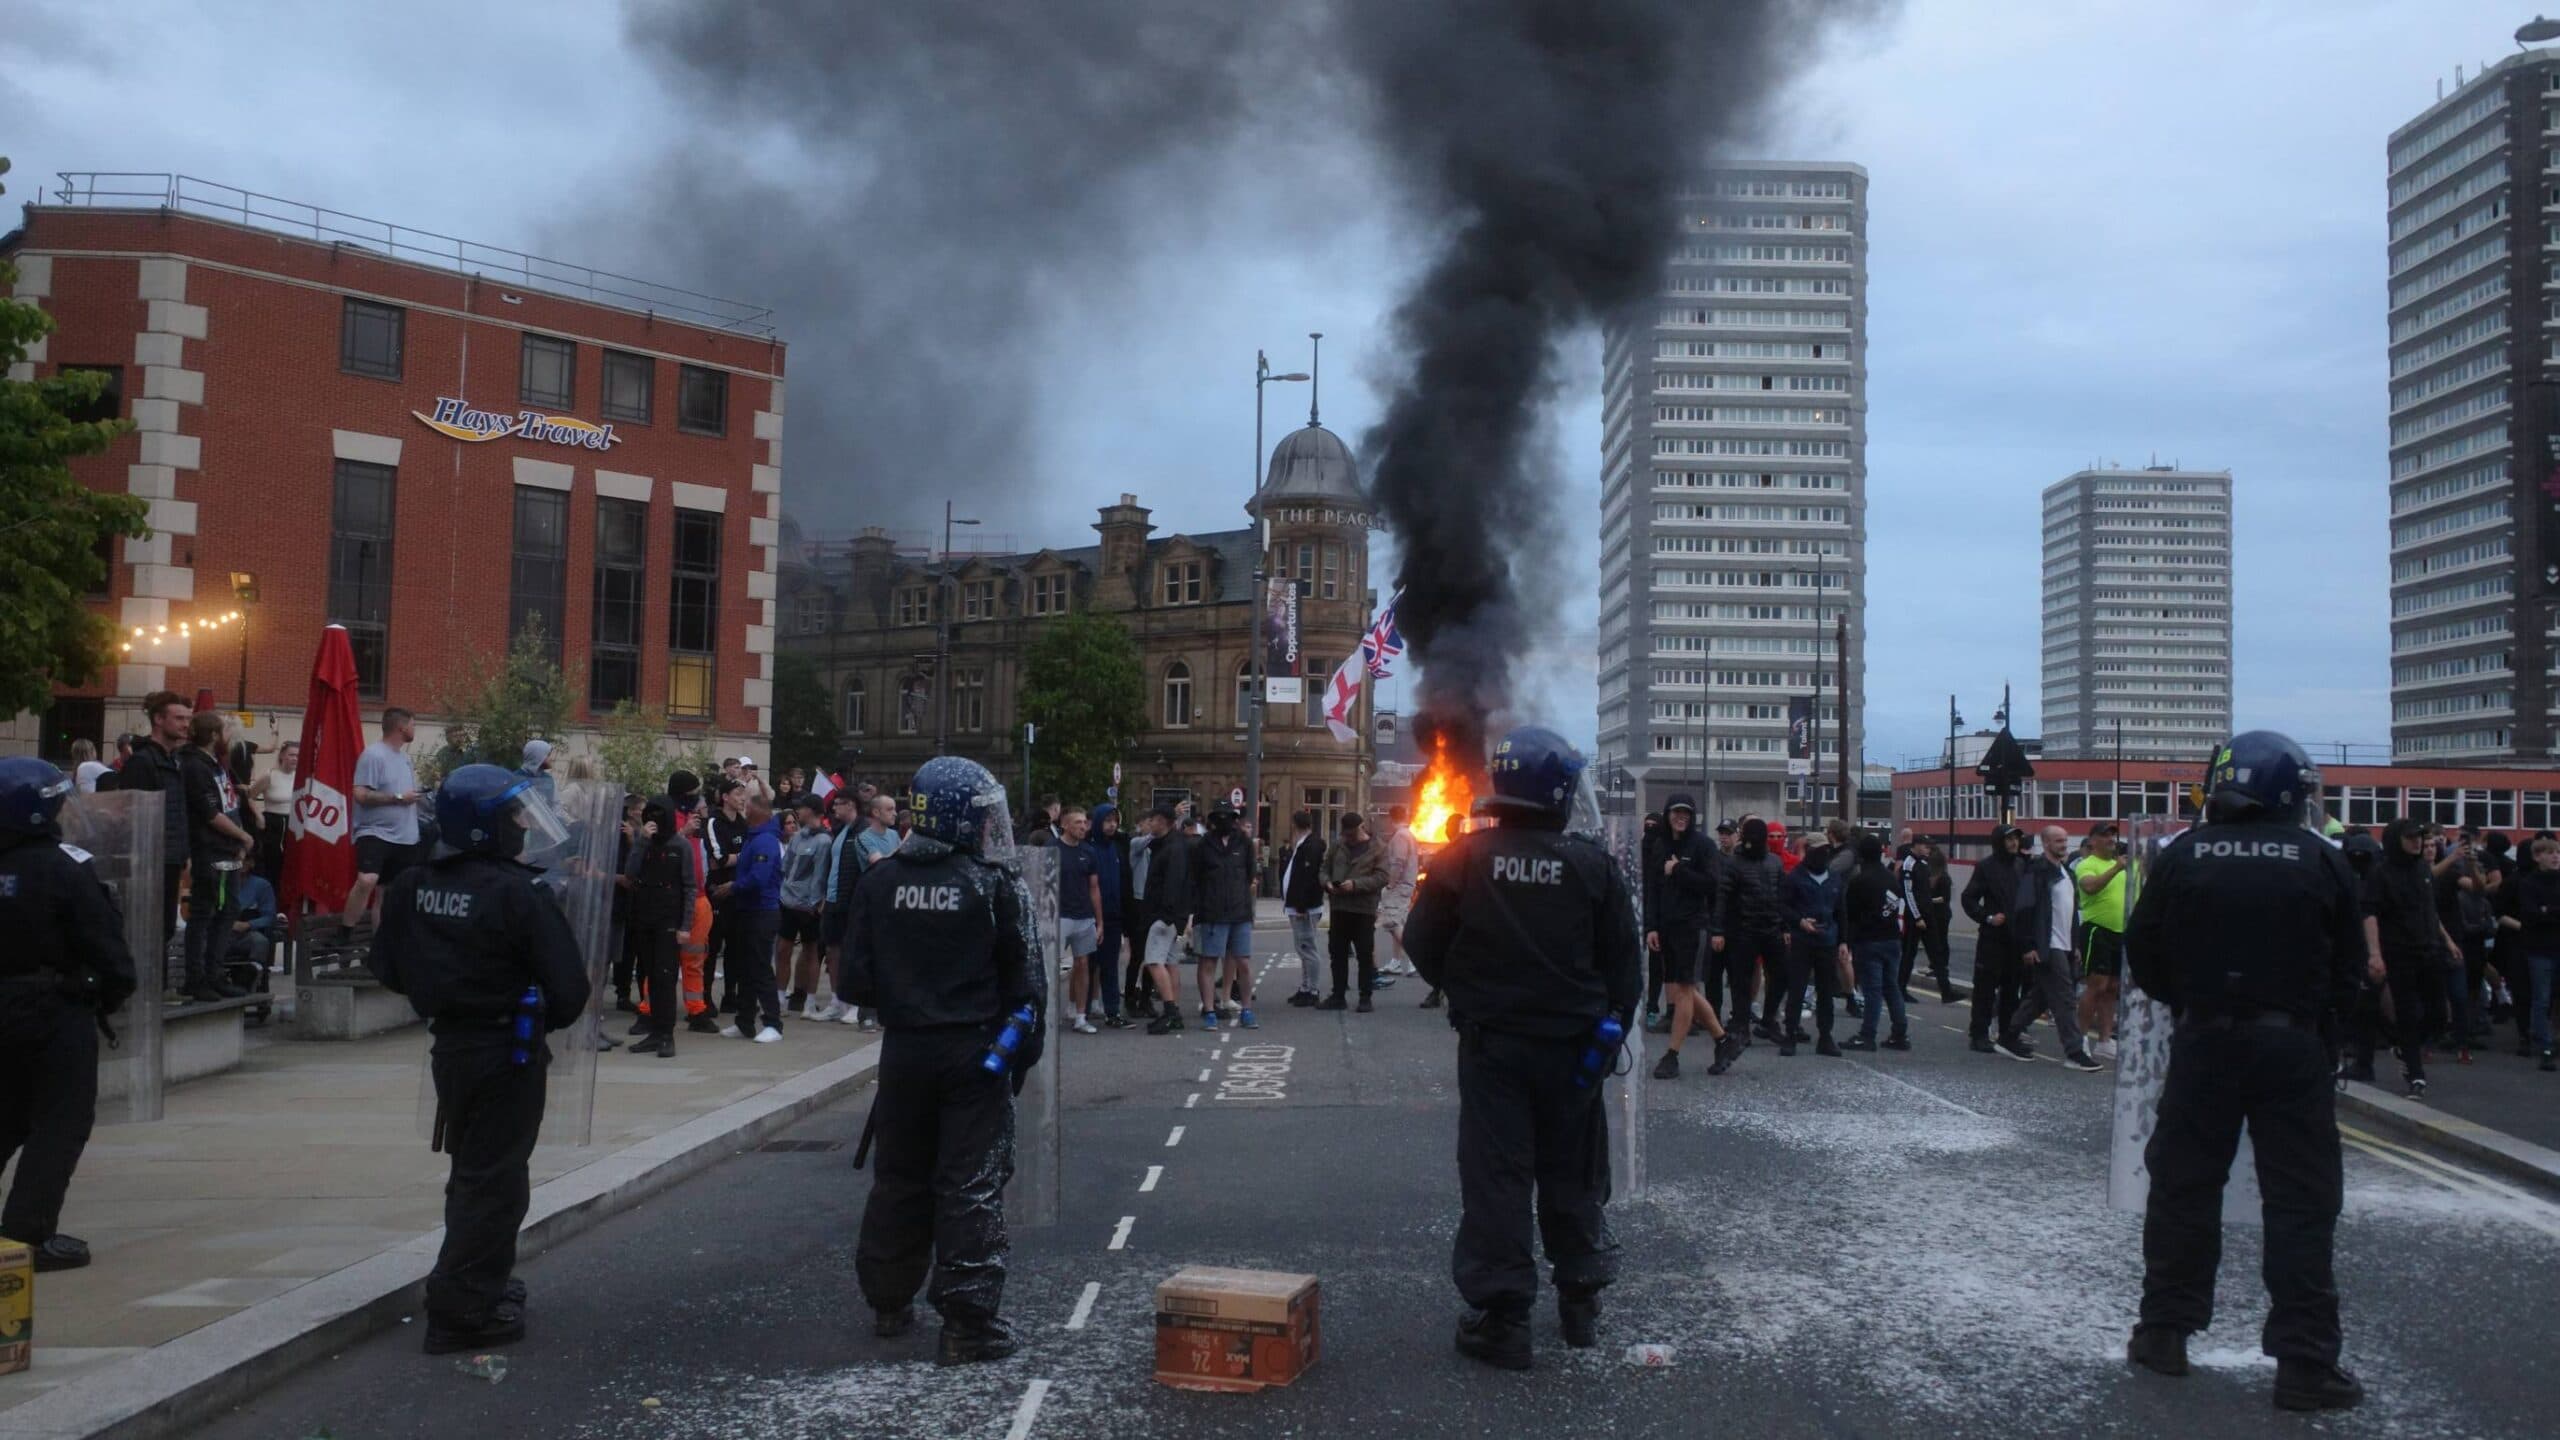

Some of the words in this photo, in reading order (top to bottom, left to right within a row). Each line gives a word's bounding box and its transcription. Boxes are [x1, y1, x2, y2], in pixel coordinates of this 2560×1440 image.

[433, 397, 513, 437] Hays
[518, 411, 613, 450] Travel
[1279, 509, 1315, 523] THE
[2194, 841, 2300, 861] POLICE
[1493, 855, 1563, 885] POLICE
[416, 888, 473, 917] POLICE
[894, 885, 960, 911] POLICE
[1215, 1045, 1296, 1100] DISABLED
[1191, 1350, 1211, 1372] 24
[1226, 1352, 1250, 1364] MAX
